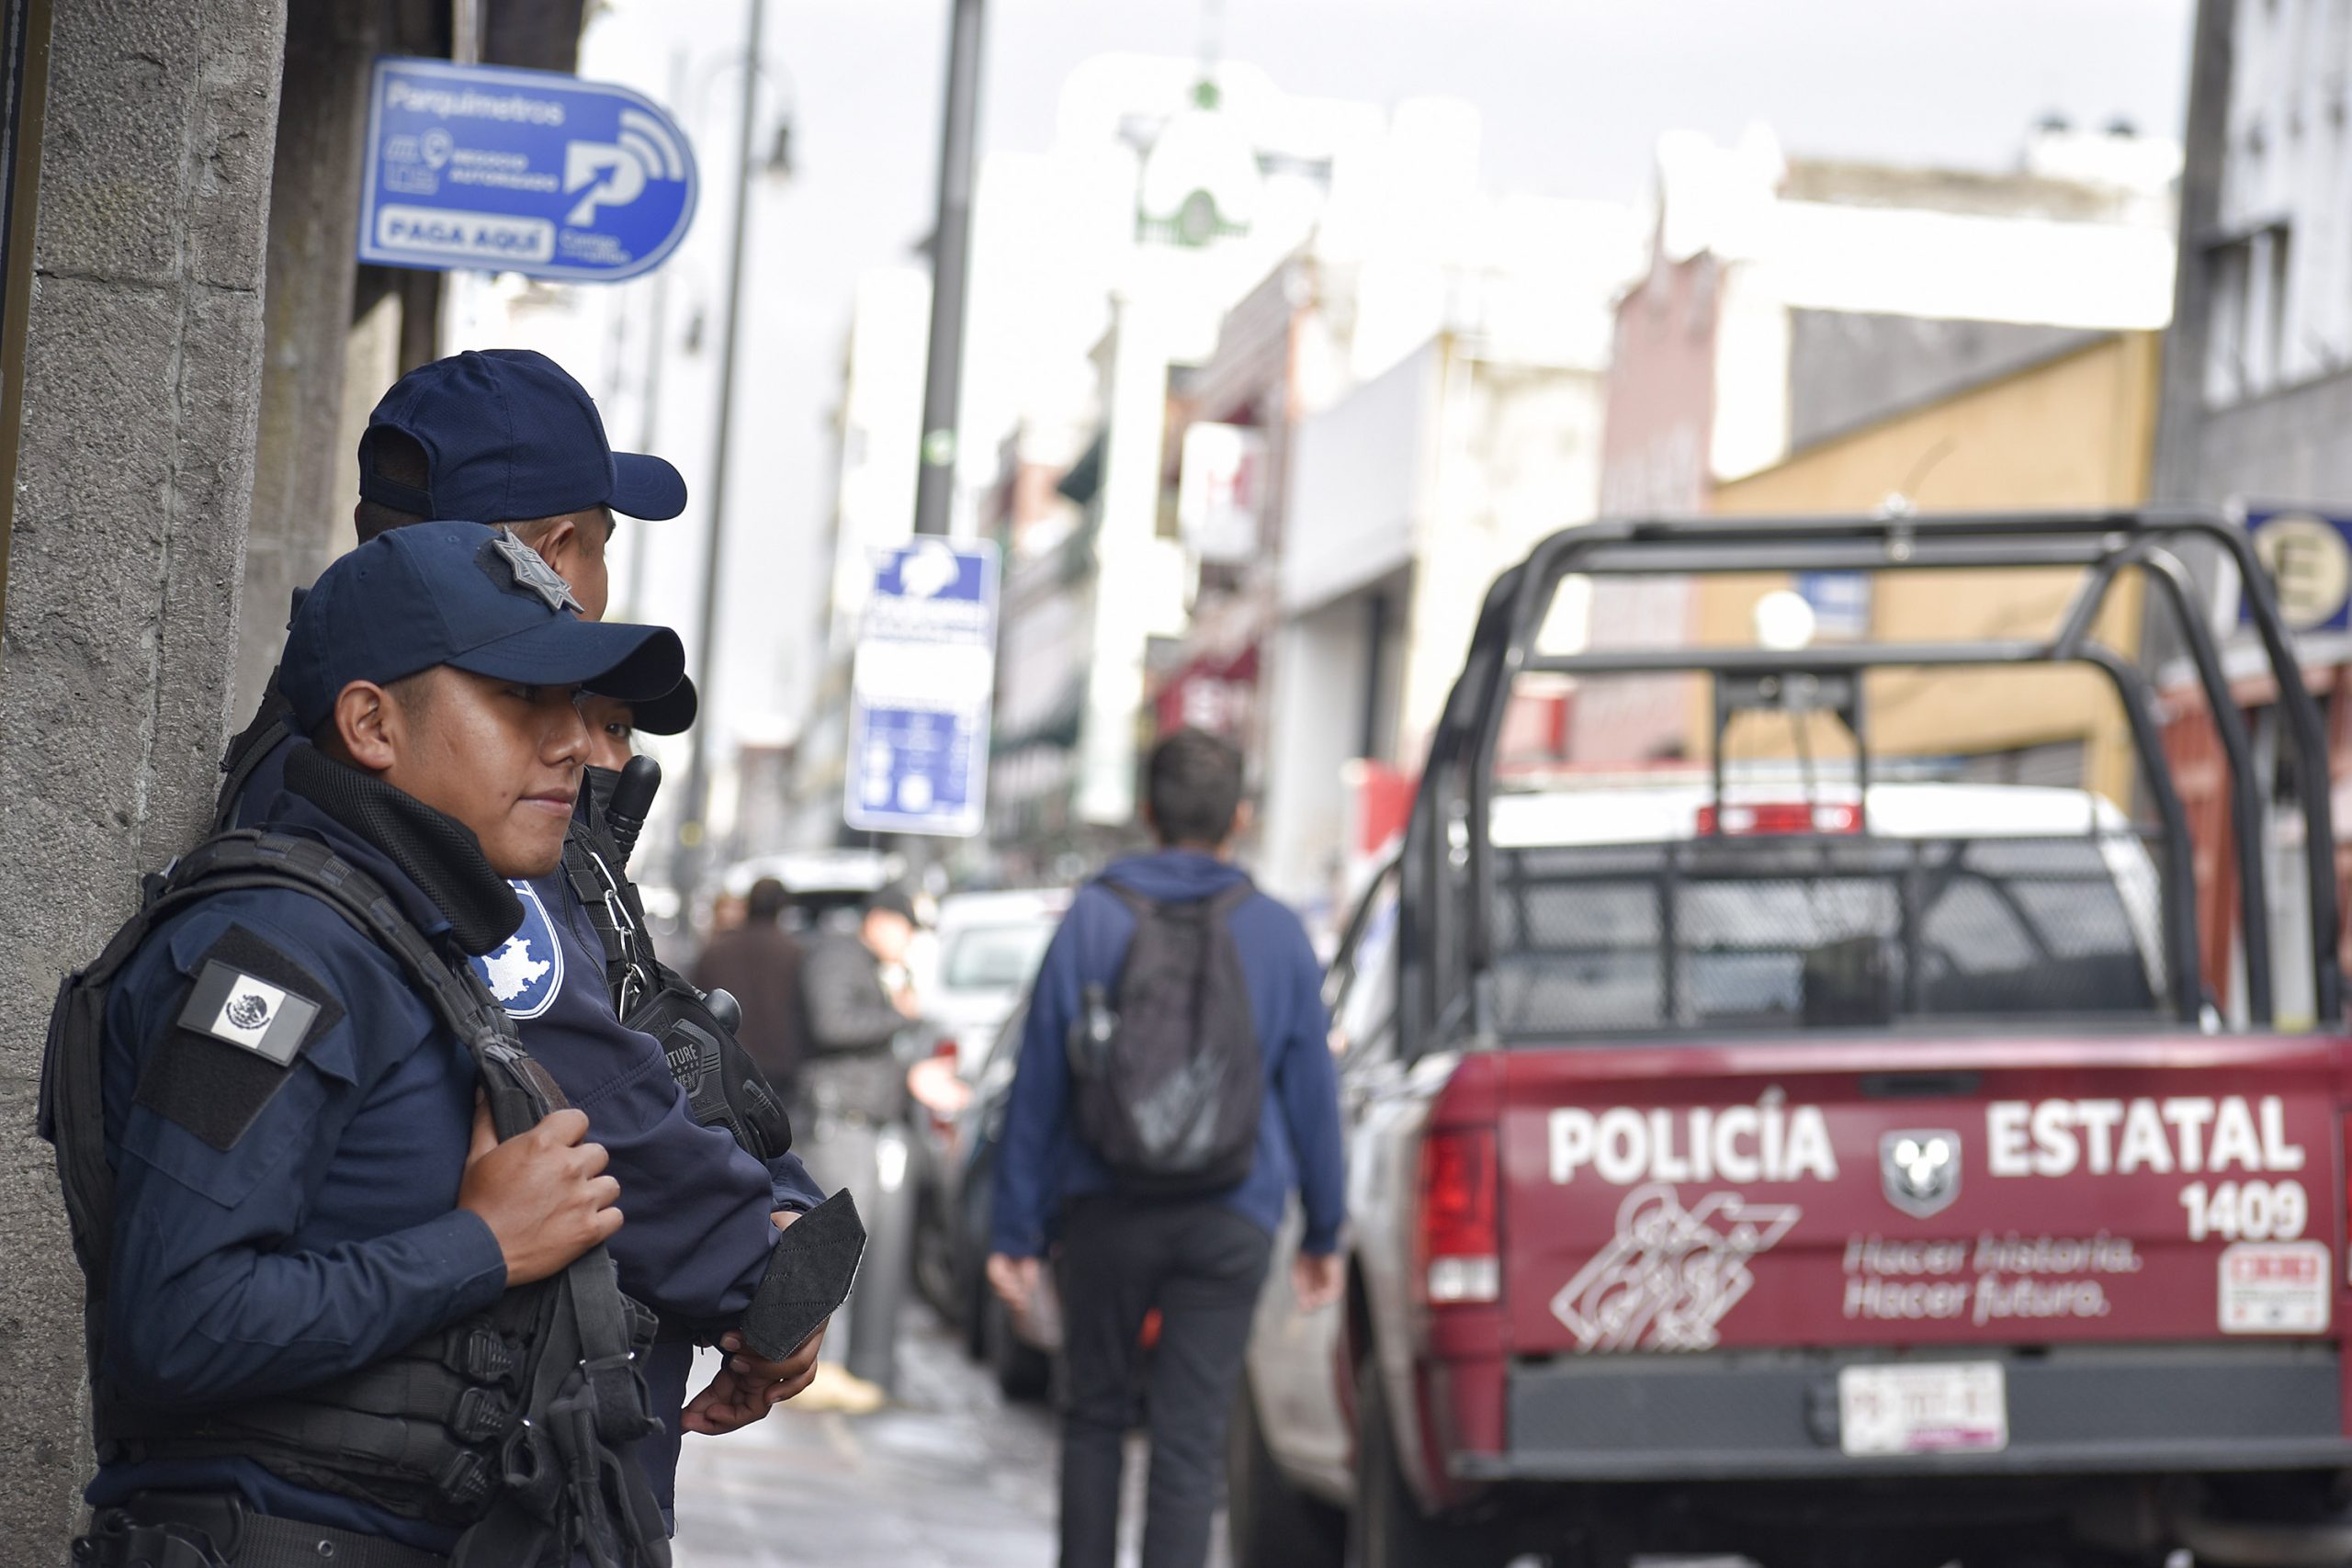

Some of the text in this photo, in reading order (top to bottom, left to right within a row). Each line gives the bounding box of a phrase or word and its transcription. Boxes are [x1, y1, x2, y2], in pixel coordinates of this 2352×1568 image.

[389, 220, 464, 245] PAGA
[1547, 1086, 2306, 1185] POLICÍA ESTATAL
[2178, 1179, 2308, 1242] 1409
[1843, 1232, 1969, 1275] Hacer
[1843, 1275, 1973, 1319] Hacer
